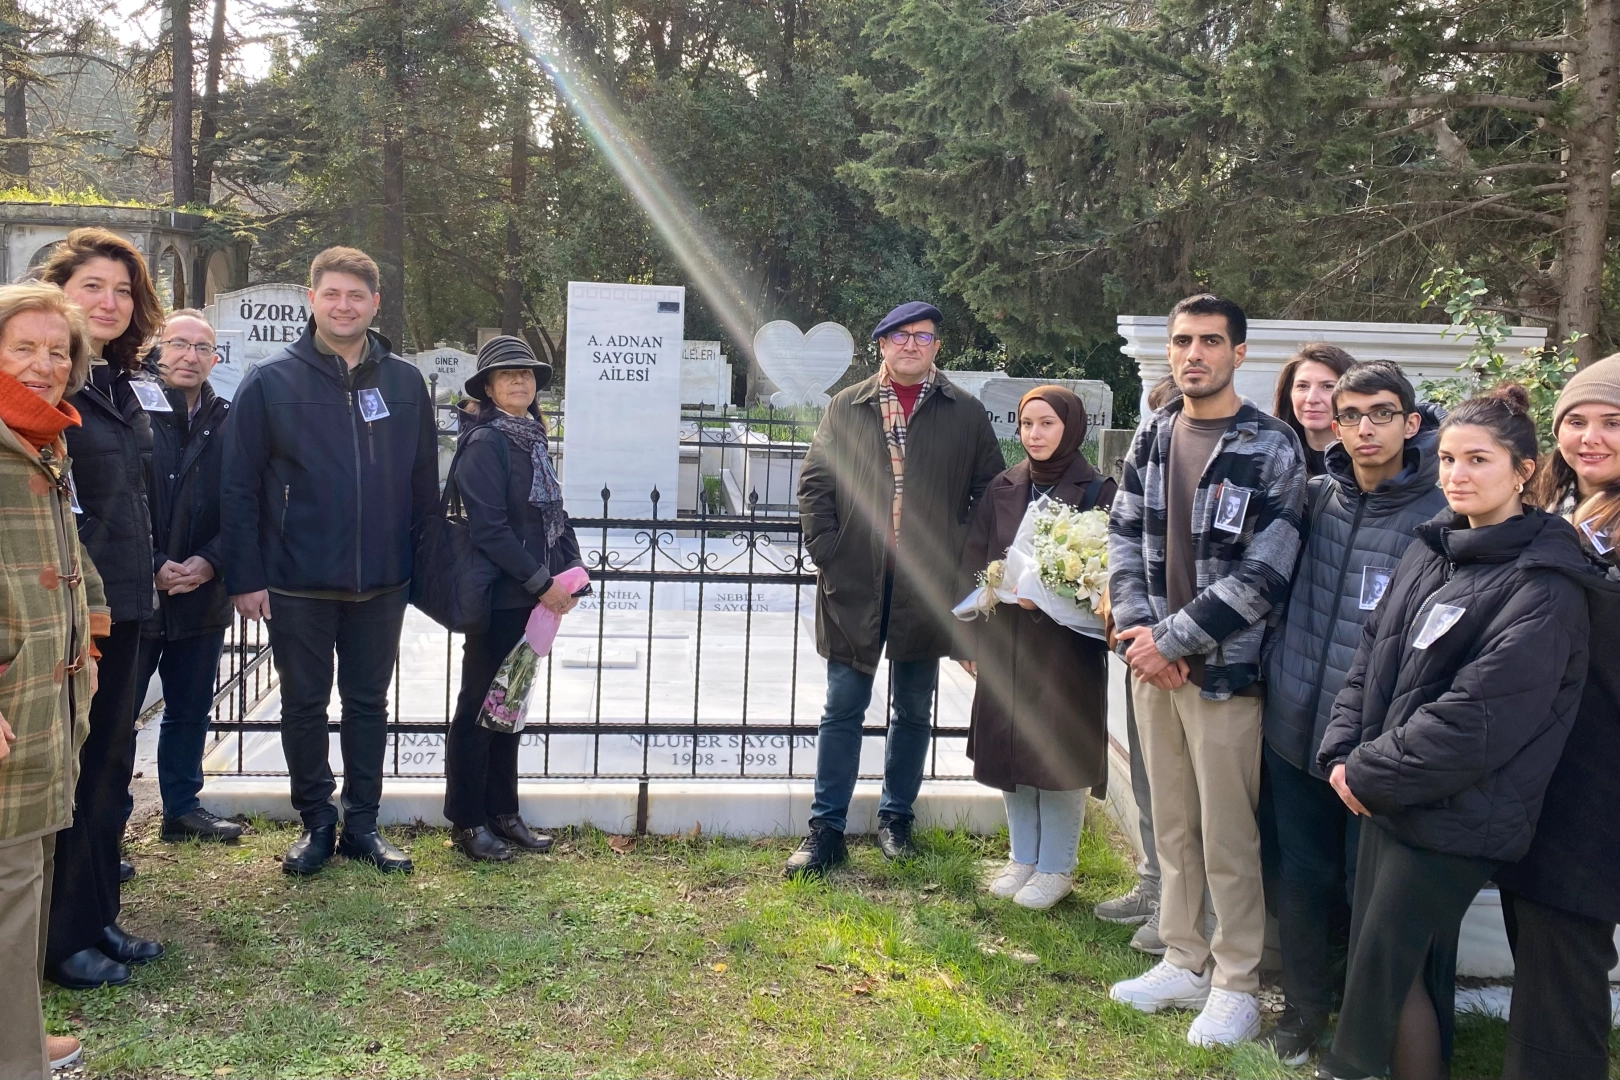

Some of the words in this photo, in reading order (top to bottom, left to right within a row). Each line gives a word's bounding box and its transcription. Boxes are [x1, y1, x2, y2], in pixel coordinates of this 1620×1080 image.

[240, 299, 310, 322] ÖZORA
[247, 325, 305, 343] AİLES
[587, 334, 602, 346] A.
[606, 335, 663, 348] ADNAN
[435, 356, 459, 366] GİNER
[593, 351, 657, 365] SAYGUN
[598, 365, 650, 381] AİLESİ
[386, 734, 446, 747] DNAN
[672, 753, 714, 766] 1908
[735, 753, 777, 766] 1998
